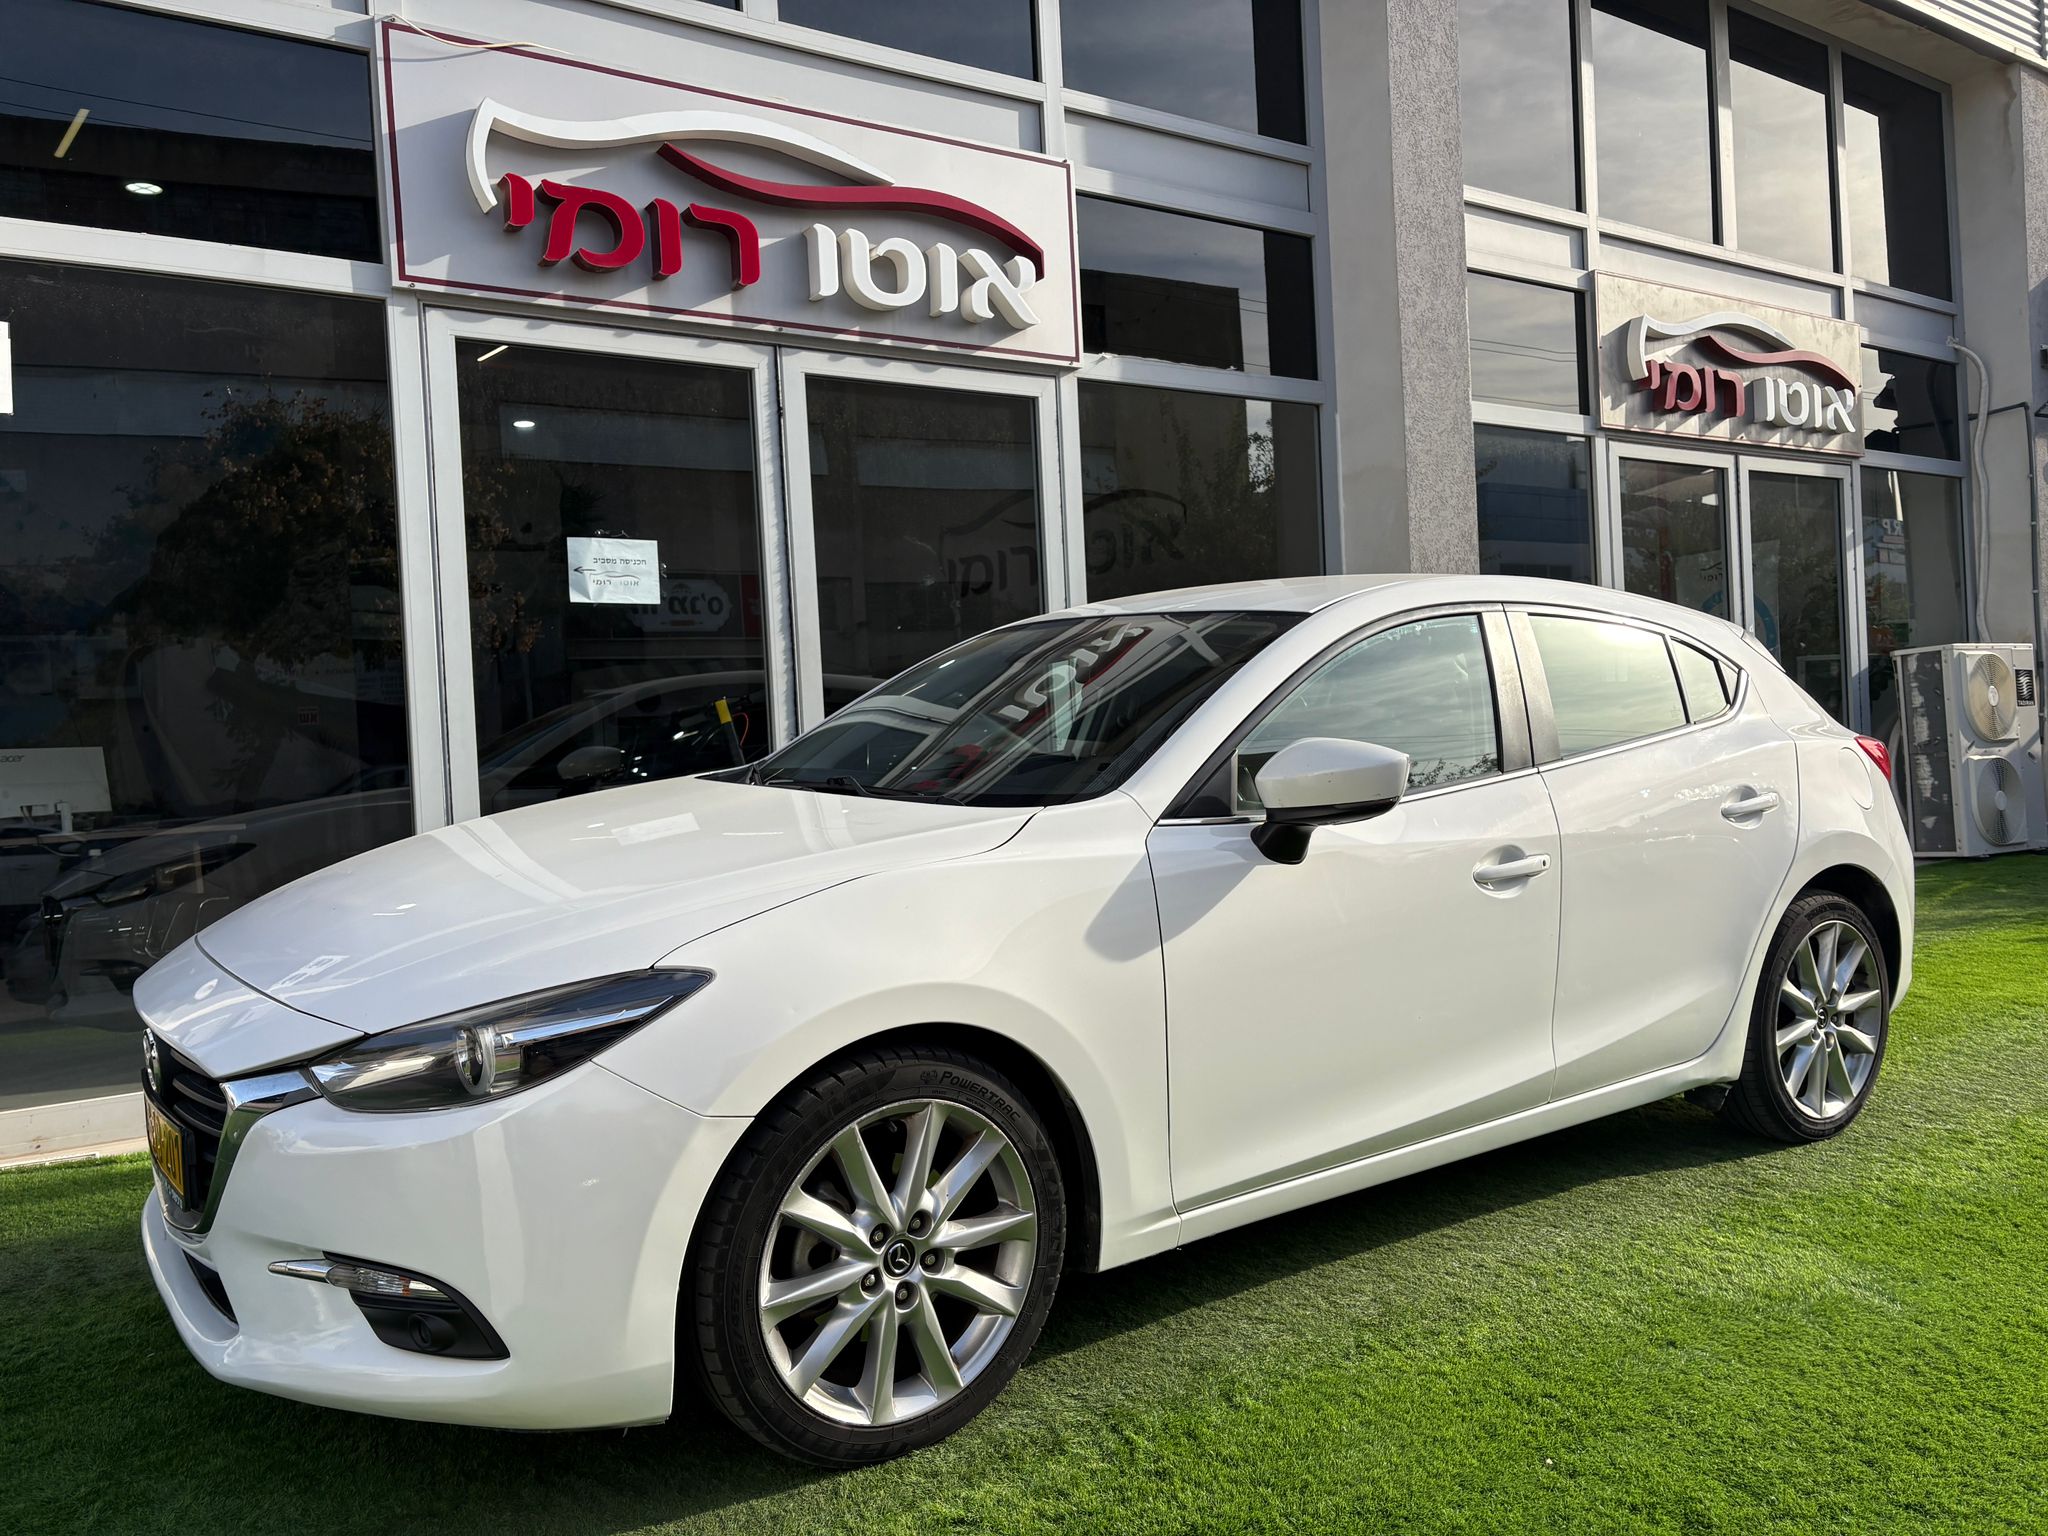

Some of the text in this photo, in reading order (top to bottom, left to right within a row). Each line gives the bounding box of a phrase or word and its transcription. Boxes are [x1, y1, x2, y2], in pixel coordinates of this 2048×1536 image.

[497, 172, 1041, 330] אוטו רומי
[1643, 360, 1856, 433] אוטו רומי
[939, 1070, 1022, 1122] POWERTRAC
